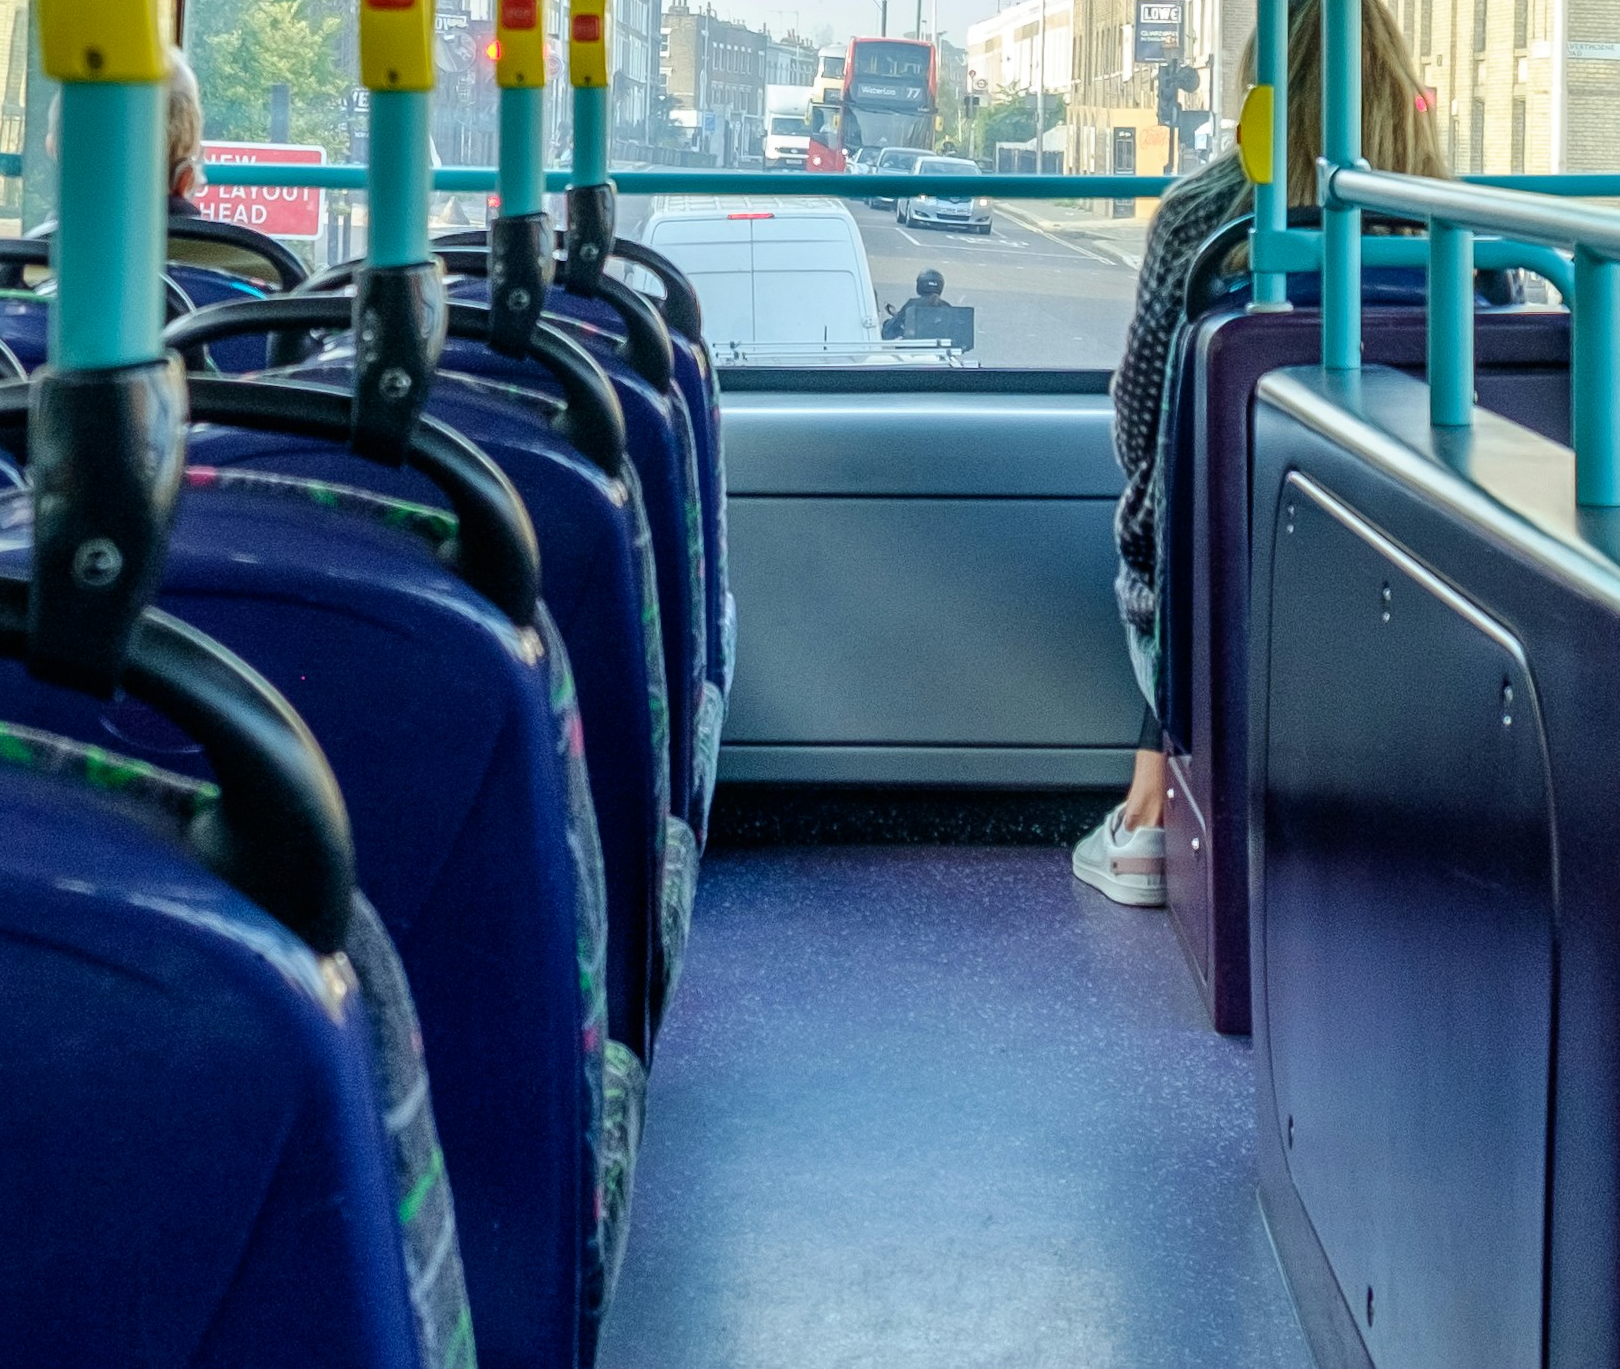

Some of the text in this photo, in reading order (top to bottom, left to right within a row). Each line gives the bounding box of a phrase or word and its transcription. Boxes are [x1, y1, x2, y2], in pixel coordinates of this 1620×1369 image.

[861, 86, 921, 99] Waterloo 77
[199, 203, 268, 225] HEAD
